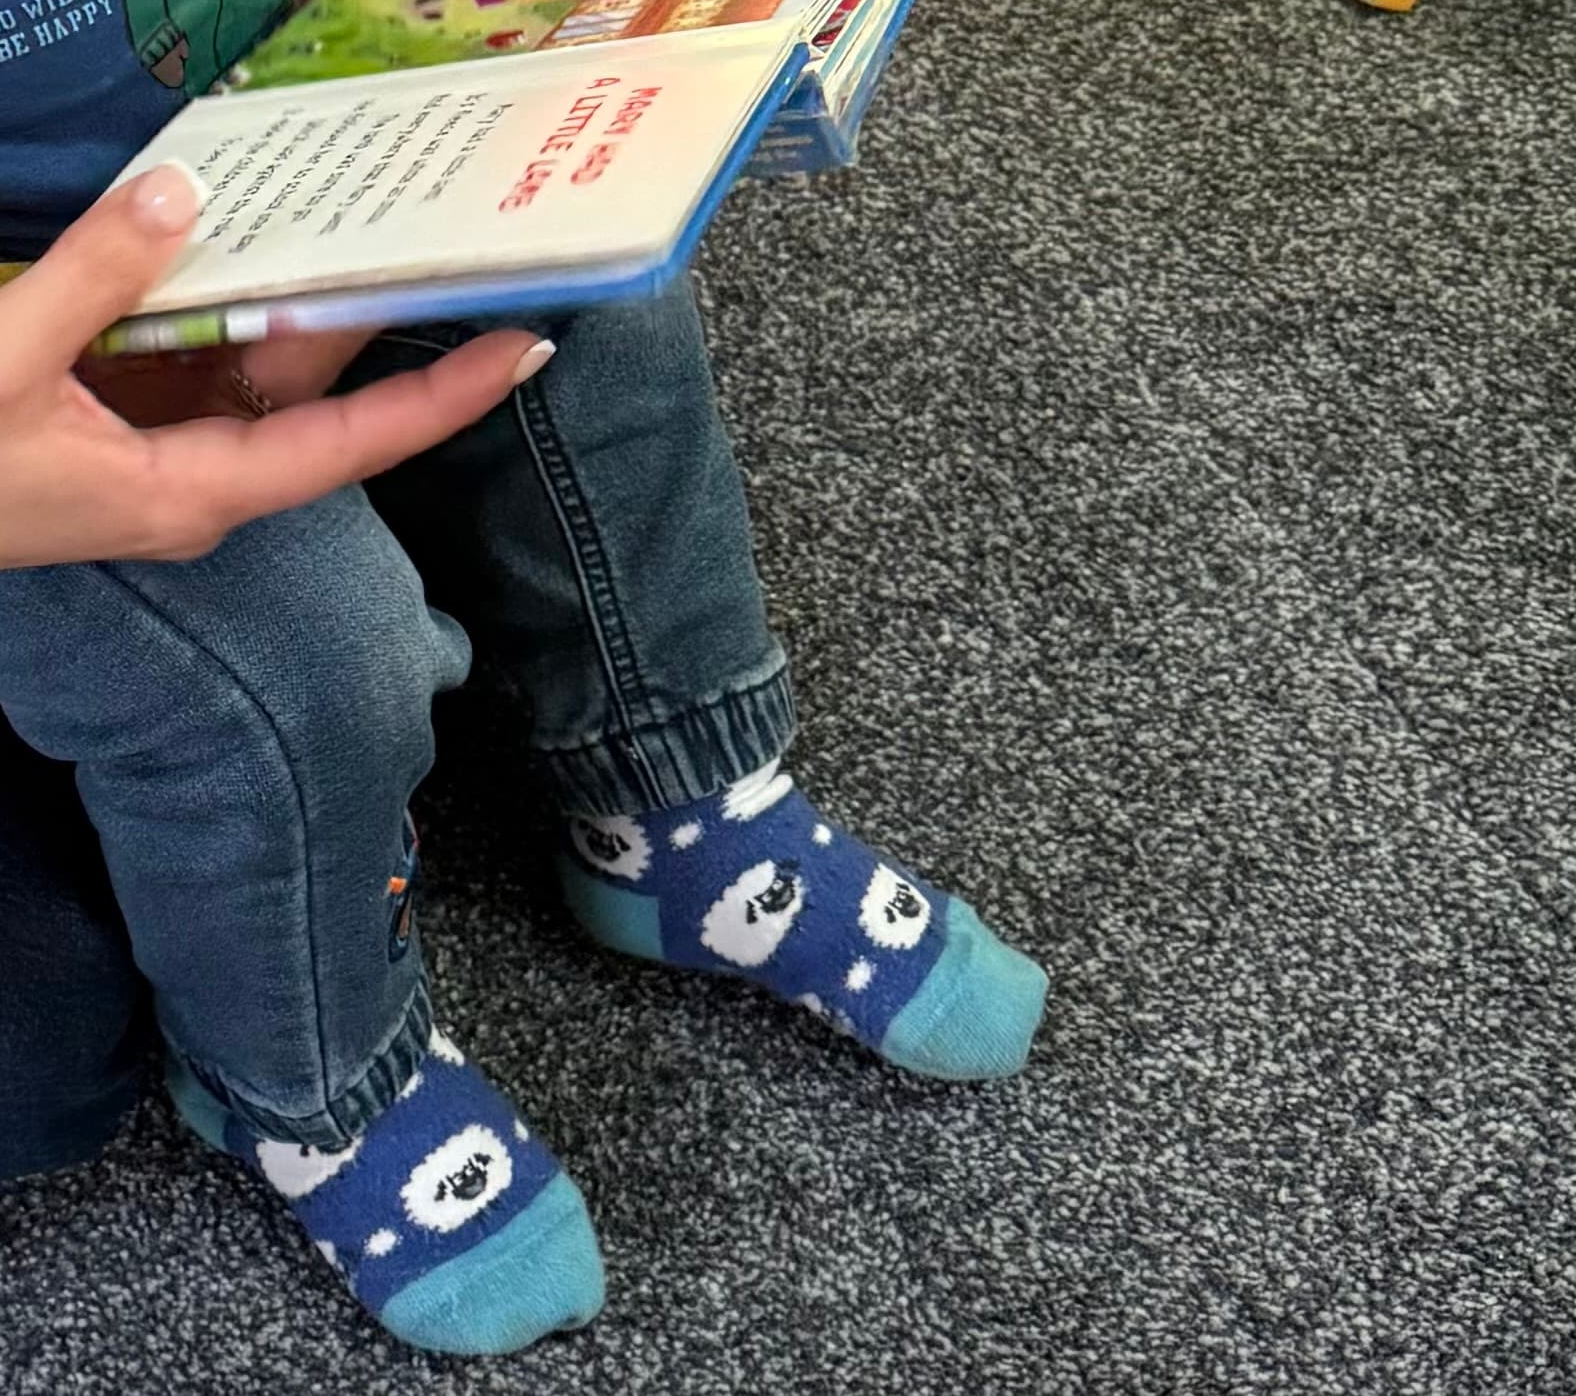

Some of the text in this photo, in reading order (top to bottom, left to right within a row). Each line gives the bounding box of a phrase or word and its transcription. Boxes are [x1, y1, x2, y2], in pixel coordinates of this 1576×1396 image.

[587, 77, 621, 90] A
[539, 95, 608, 155] LITTLE
[603, 87, 663, 135] MARY
